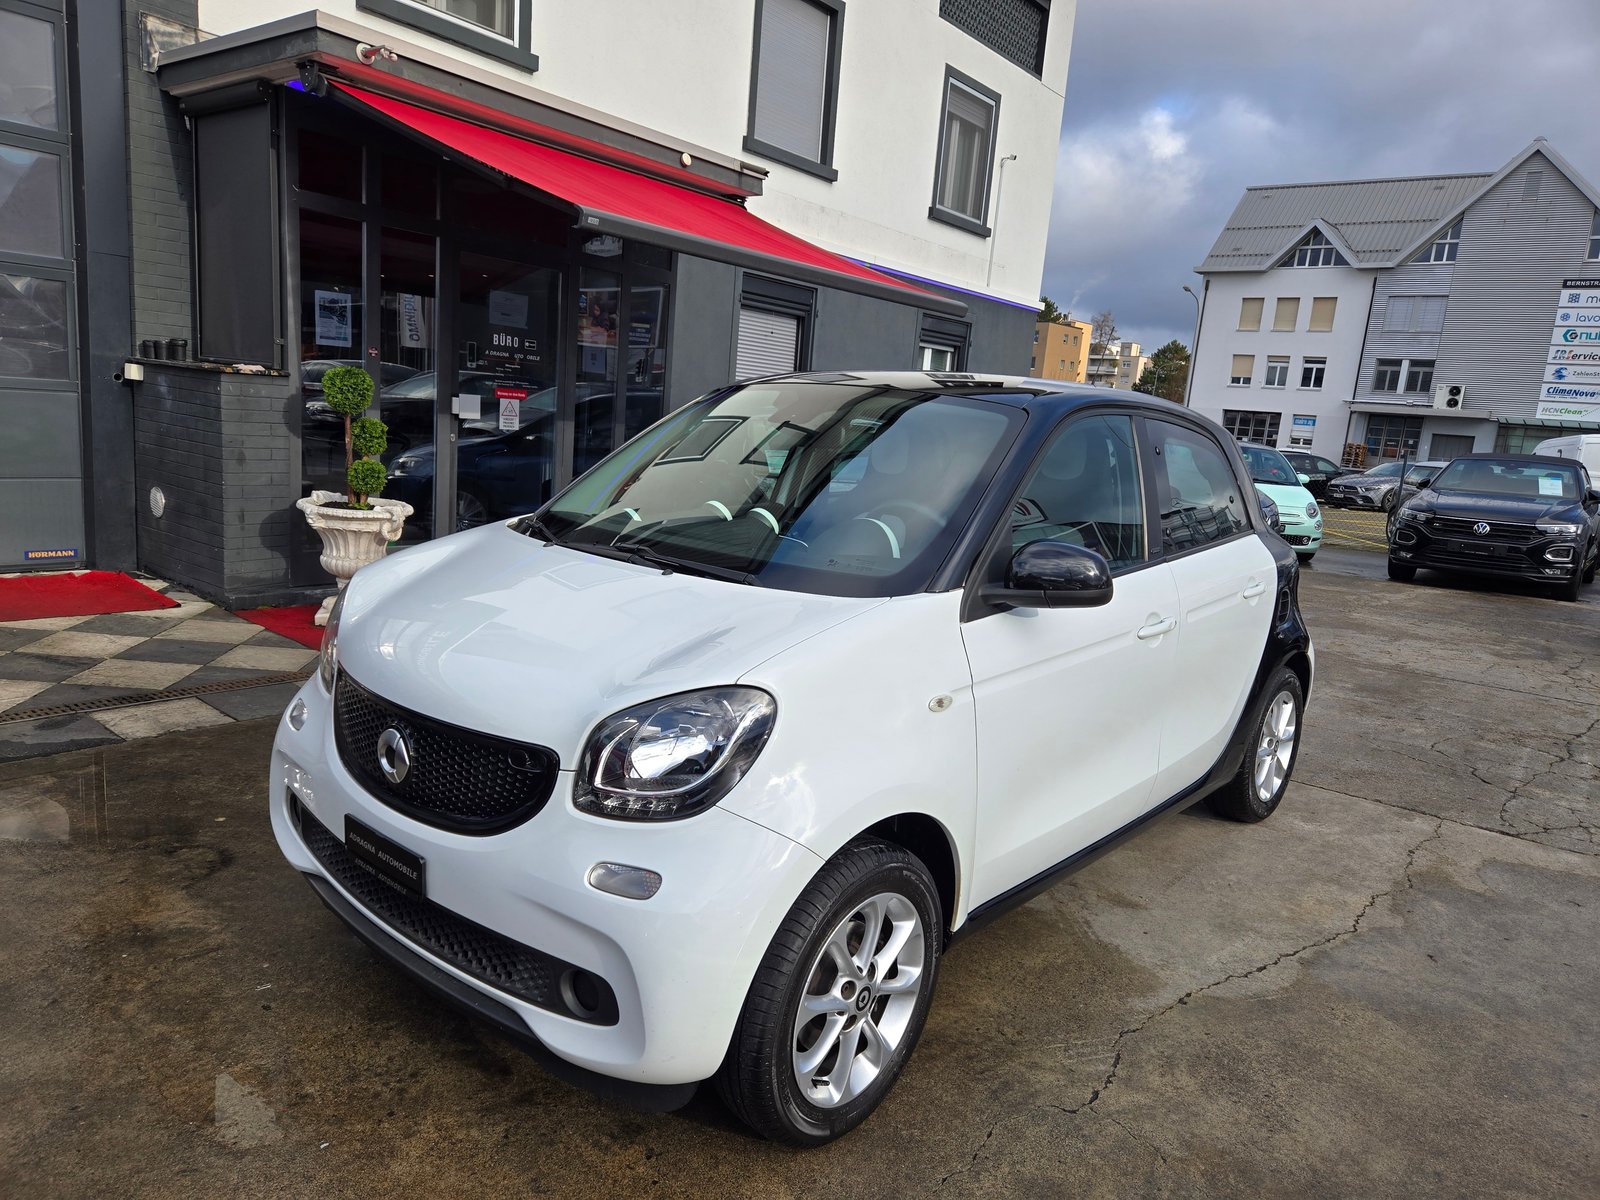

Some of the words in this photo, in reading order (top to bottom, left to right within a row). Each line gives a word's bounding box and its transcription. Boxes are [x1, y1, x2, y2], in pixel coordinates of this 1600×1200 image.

[1585, 295, 1600, 304] m
[493, 333, 519, 348] BÜRO
[1579, 330, 1600, 341] nu
[1552, 349, 1600, 360] SRServic
[1546, 386, 1597, 398] ClimaNova
[1541, 407, 1583, 415] HCNClean
[349, 832, 376, 855] ADRAGNA
[378, 851, 418, 880] AUTOMOBILE
